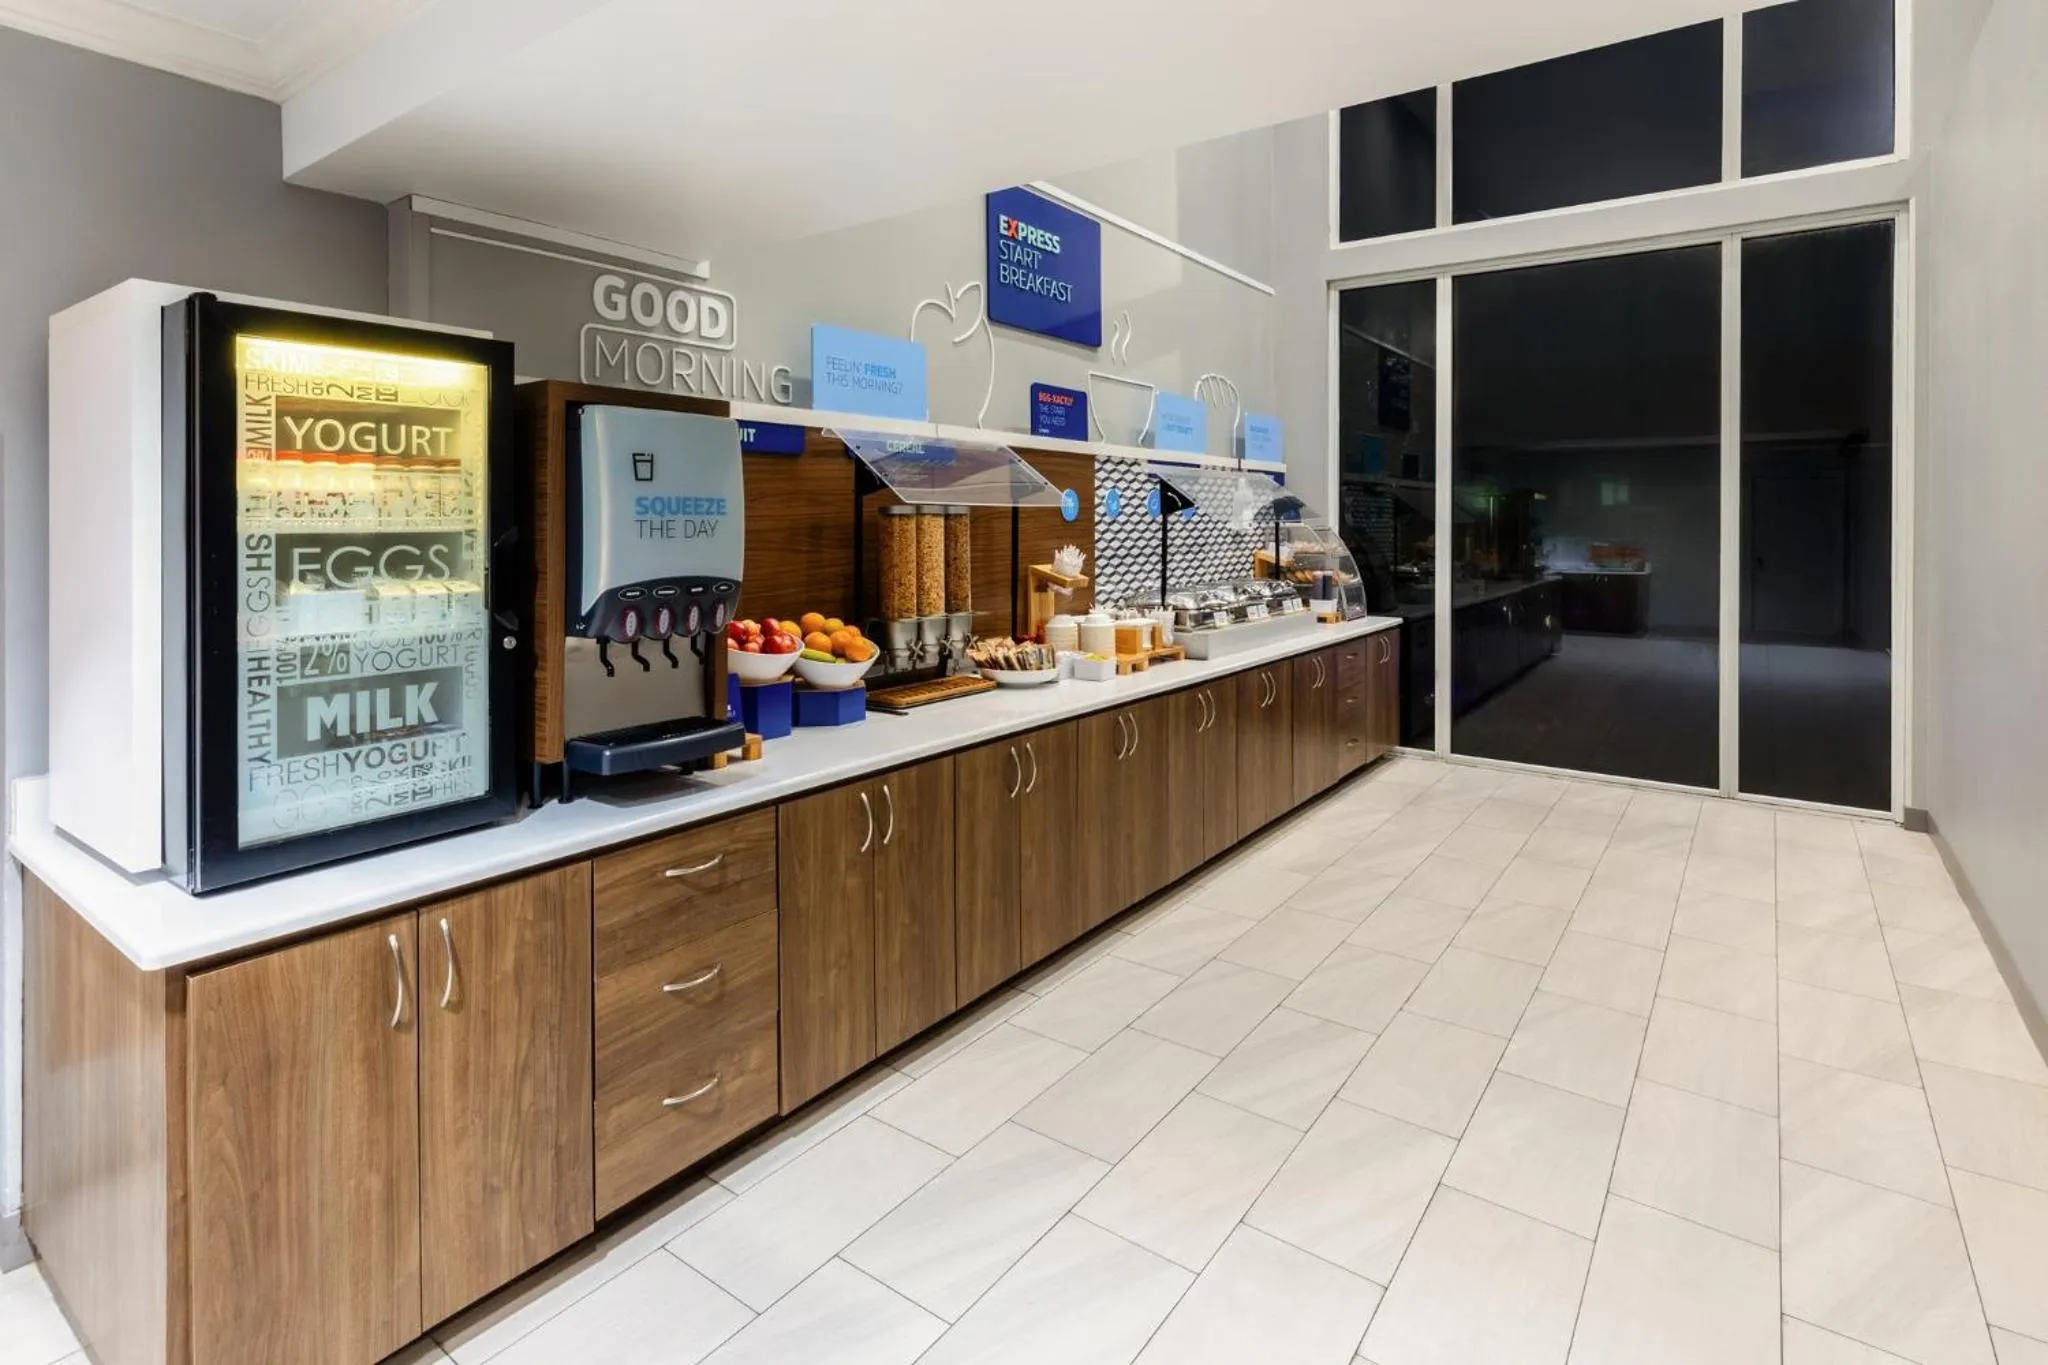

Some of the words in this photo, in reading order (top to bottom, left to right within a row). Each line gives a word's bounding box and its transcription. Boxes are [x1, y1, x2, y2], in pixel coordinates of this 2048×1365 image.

[999, 214, 1061, 254] EXPRESS
[1000, 240, 1042, 269] START
[1000, 263, 1073, 302] BREAKFAST
[593, 274, 728, 338] GOOD
[245, 372, 310, 396] FRESH
[595, 335, 793, 404] MORNING
[826, 371, 849, 388] THIS
[864, 363, 897, 379] FRESH
[245, 393, 273, 447] MILK
[283, 415, 453, 457] YOGURT
[635, 496, 727, 517] SQUEEZE
[634, 519, 677, 539] THE
[684, 519, 719, 539] DAY
[292, 544, 450, 590] EGGS
[354, 645, 460, 673] YOGURT
[247, 655, 272, 768] HEALTHY
[307, 682, 439, 742] MILK
[248, 752, 340, 792] FRESH
